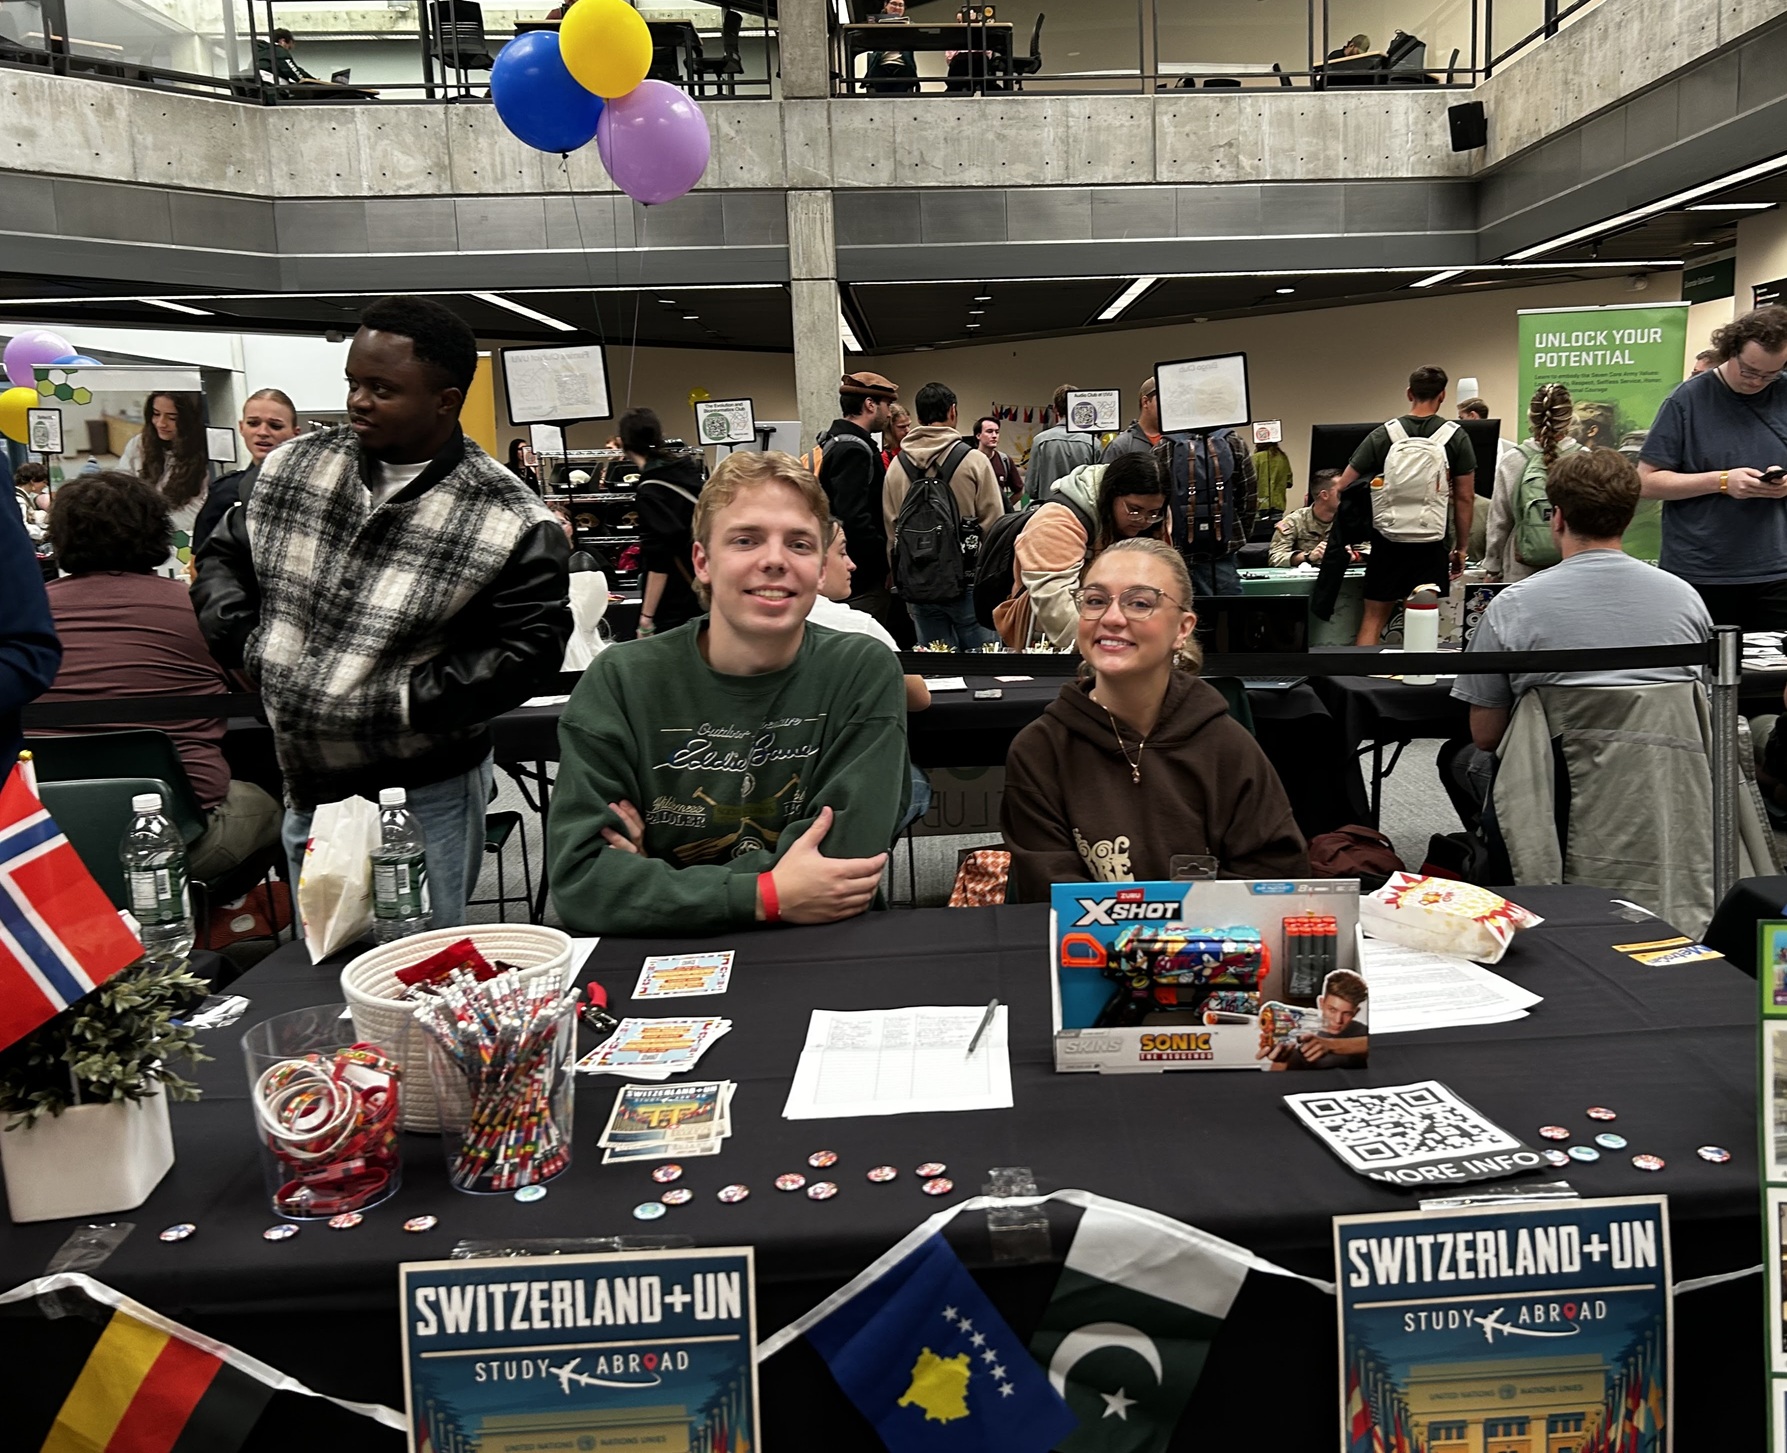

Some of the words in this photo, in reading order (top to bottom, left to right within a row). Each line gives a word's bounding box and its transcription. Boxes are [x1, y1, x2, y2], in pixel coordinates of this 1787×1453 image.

[1535, 330, 1608, 348] UNLOCK
[1612, 328, 1662, 345] YOUR
[1534, 349, 1635, 368] POTENTIAL
[697, 722, 751, 739] Outdoor
[652, 739, 749, 772] Eddie
[652, 796, 706, 813] Wilderness
[645, 812, 706, 828] PADDLER
[1064, 1038, 1124, 1054] SKINS
[1140, 1033, 1212, 1051] SONIC
[1140, 1053, 1158, 1061] THE
[1162, 1052, 1213, 1060] HEDGEHOG
[625, 1085, 718, 1098] SWITZERLAND+UN
[1369, 1162, 1466, 1184] MORE
[1462, 1151, 1540, 1175] INFO
[1348, 1220, 1657, 1288] SWITZERLAND+UN
[415, 1271, 742, 1336] SWITZERLAND+UN
[1404, 1308, 1474, 1332] STUDY
[475, 1358, 550, 1382] STUDY
[1429, 1392, 1459, 1400] UNITED
[1460, 1389, 1495, 1398] NATIONS
[1520, 1385, 1557, 1394] NATIONS
[505, 1443, 535, 1452] UNITED
[537, 1441, 574, 1449] NATIONS
[601, 1437, 639, 1446] NATIONS
